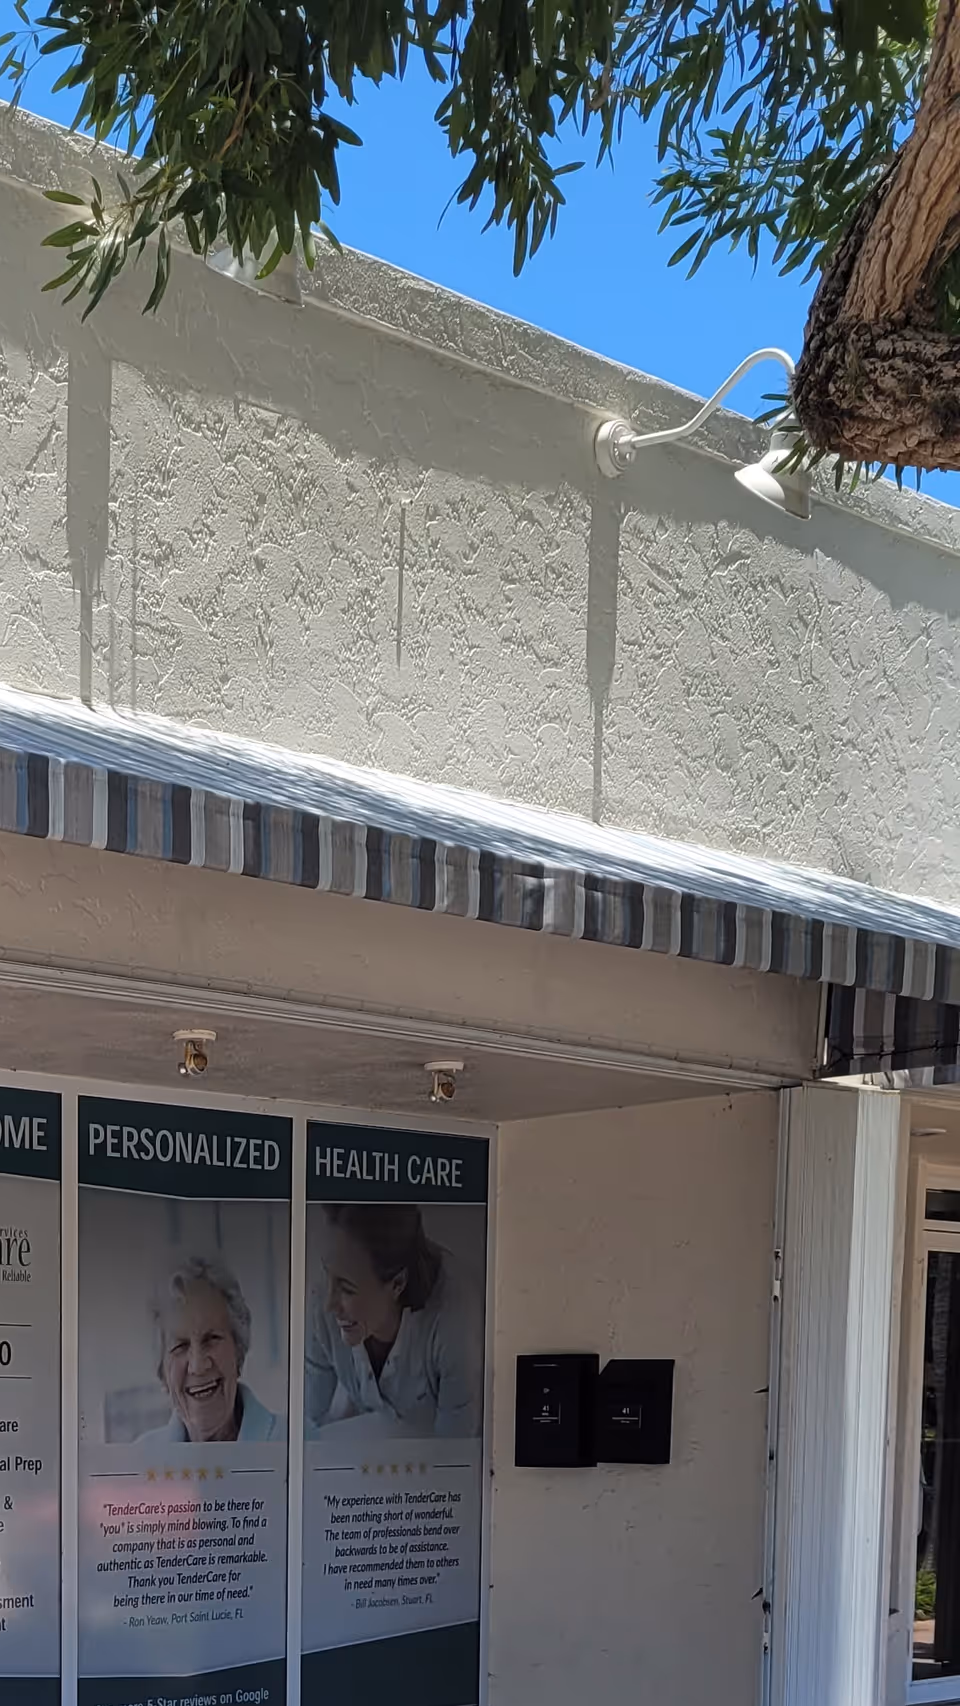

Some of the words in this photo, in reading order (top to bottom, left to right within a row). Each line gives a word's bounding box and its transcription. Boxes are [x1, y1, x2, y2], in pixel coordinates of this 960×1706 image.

[88, 1123, 281, 1171] PERSONALIZED
[315, 1146, 399, 1183] HEALTH
[407, 1155, 463, 1188] CARE
[2, 1269, 32, 1282] Reliable
[15, 1457, 42, 1475] Prep
[4, 1496, 13, 1511] &
[167, 1501, 200, 1516] passion
[203, 1501, 213, 1512] to
[214, 1500, 226, 1511] be
[227, 1499, 250, 1511] there
[251, 1498, 264, 1511] for
[127, 1521, 134, 1533] is
[136, 1520, 166, 1535] simply
[167, 1518, 190, 1531] mind
[192, 1518, 229, 1531] blowing.
[230, 1517, 241, 1528] To
[242, 1516, 260, 1530] find
[261, 1518, 267, 1527] a
[330, 1512, 350, 1524] been
[352, 1510, 382, 1524] nothing
[383, 1509, 403, 1521] short
[405, 1509, 413, 1521] of
[325, 1529, 339, 1541] The
[341, 1530, 361, 1540] team
[363, 1527, 372, 1539] of
[372, 1525, 422, 1540] professionals
[423, 1524, 442, 1535] bend
[443, 1526, 460, 1535] over
[112, 1541, 155, 1554] company
[157, 1538, 176, 1550] that
[177, 1537, 185, 1549] is
[186, 1539, 197, 1548] as
[199, 1534, 236, 1550] personal
[237, 1533, 255, 1546] and
[335, 1544, 377, 1557] backwards
[379, 1544, 387, 1554] to
[388, 1543, 398, 1554] be
[400, 1542, 408, 1554] of
[409, 1541, 449, 1552] assistance.
[97, 1557, 142, 1572] authentic
[143, 1560, 154, 1569] as
[156, 1554, 207, 1568] TenderCare
[208, 1553, 216, 1565] is
[217, 1550, 268, 1565] remarkable.
[323, 1563, 327, 1575] I
[328, 1562, 347, 1574] have
[349, 1559, 404, 1572] recommended
[405, 1557, 425, 1569] them
[426, 1558, 435, 1568] to
[436, 1556, 459, 1567] others
[127, 1574, 157, 1588] Thank
[158, 1576, 175, 1588] you
[176, 1571, 227, 1584] TenderCare
[228, 1569, 241, 1583] for
[344, 1579, 352, 1591] in
[354, 1577, 373, 1590] need
[374, 1578, 396, 1589] many
[398, 1575, 418, 1586] times
[113, 1594, 139, 1608] being
[141, 1593, 166, 1605] there
[167, 1591, 176, 1603] in
[177, 1592, 193, 1602] our
[195, 1589, 215, 1601] time
[216, 1587, 226, 1601] of
[219, 1693, 233, 1704] on
[235, 1688, 269, 1704] Google
